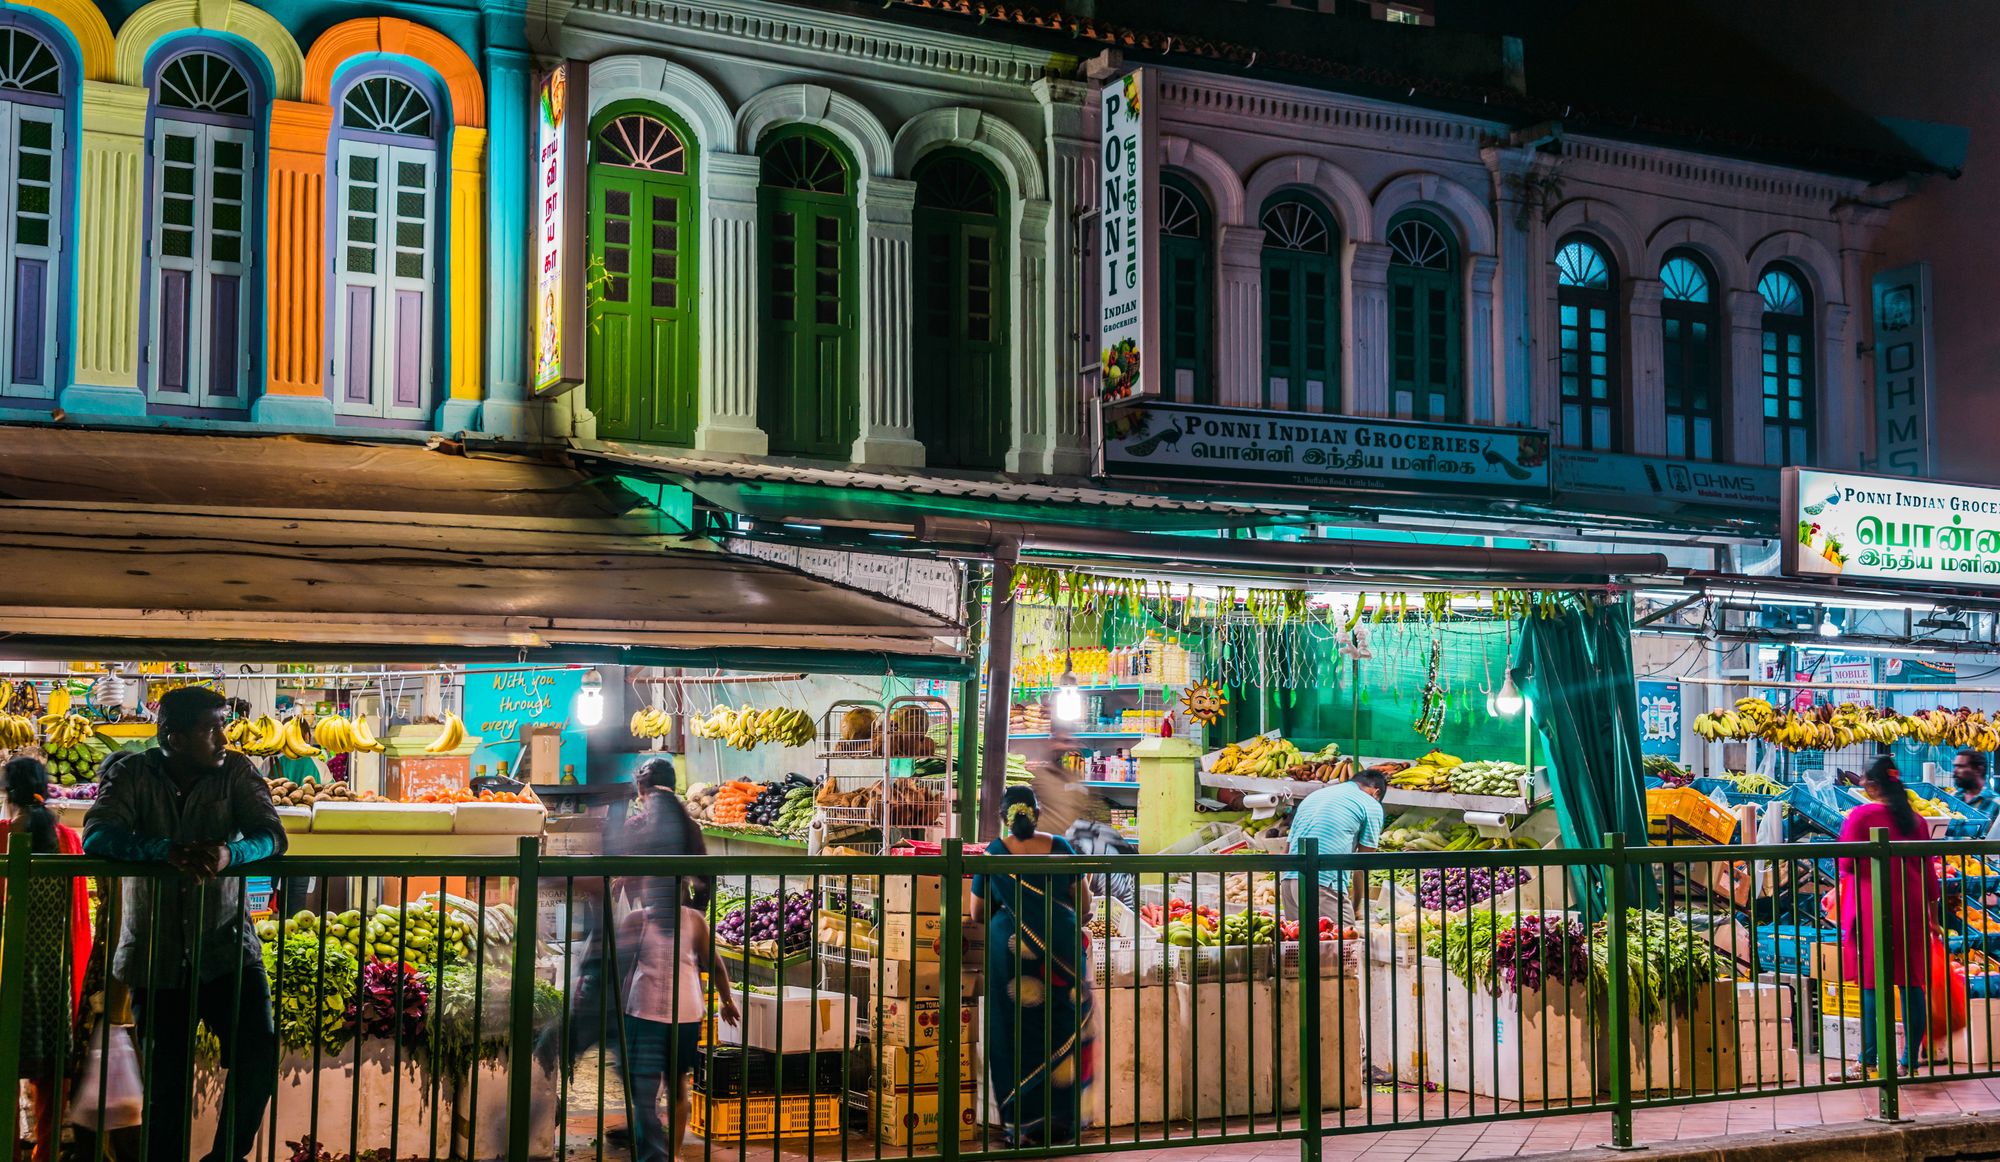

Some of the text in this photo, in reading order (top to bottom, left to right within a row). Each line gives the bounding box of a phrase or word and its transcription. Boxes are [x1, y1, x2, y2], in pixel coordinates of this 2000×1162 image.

[1105, 94, 1121, 296] PONNI
[1123, 134, 1137, 289] பொன்னி
[1104, 300, 1137, 320] INDIAN
[1103, 316, 1138, 333] GROCERIES
[1886, 341, 1918, 477] OHMS
[1184, 415, 1480, 454] PONNI INDIAN GROCERIES
[1191, 441, 1476, 475] பொன்னி இந்திய மளிகை
[1367, 479, 1385, 488] India
[1692, 473, 1755, 491] OHMS
[1724, 492, 1738, 500] and
[1844, 487, 1891, 505] PONNI
[1896, 491, 1945, 510] INDIAN
[1858, 546, 1933, 572] இந்திய
[493, 671, 556, 696] With you
[1835, 670, 1869, 679] MOBILE
[500, 692, 552, 718] through
[1846, 689, 1860, 699] and
[481, 719, 519, 740] every
